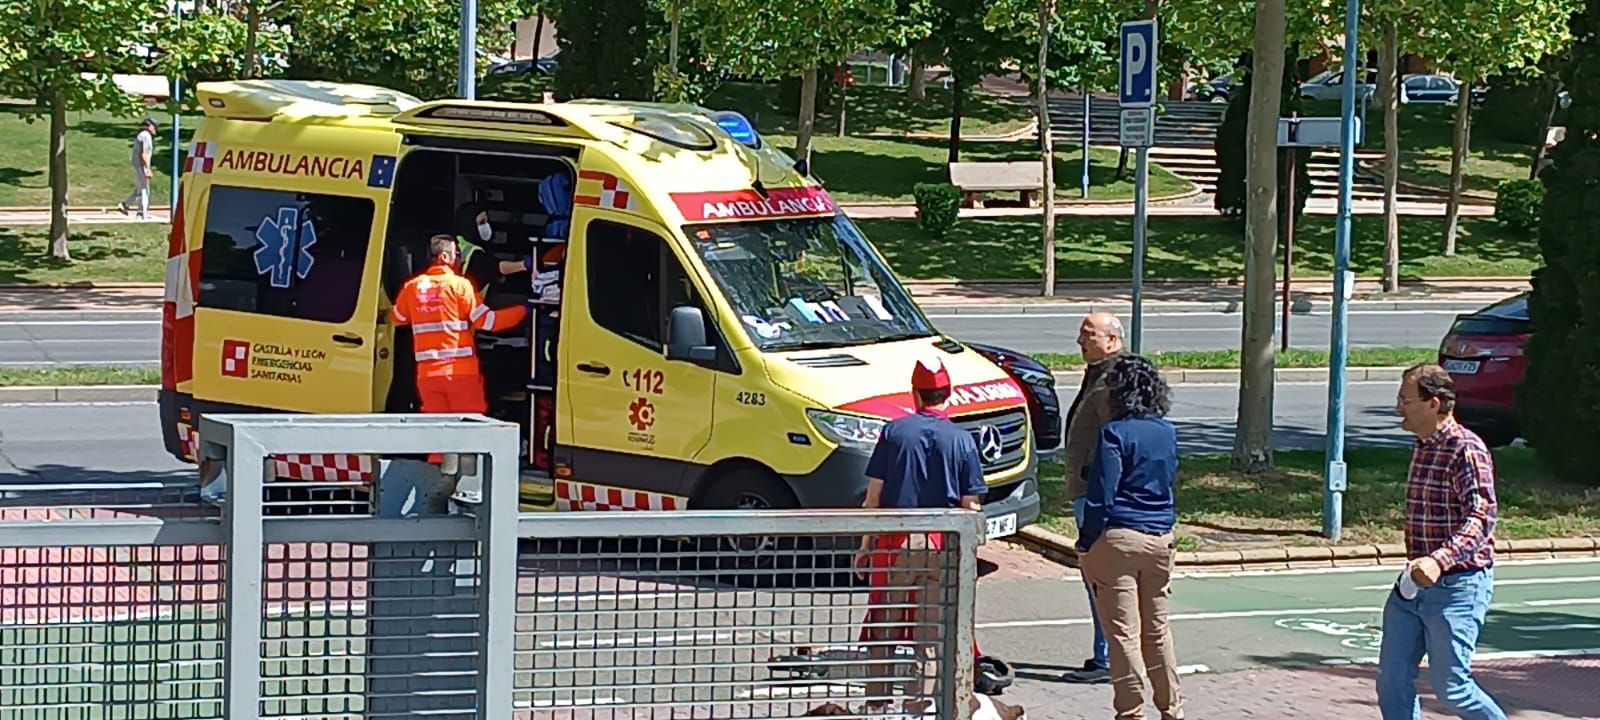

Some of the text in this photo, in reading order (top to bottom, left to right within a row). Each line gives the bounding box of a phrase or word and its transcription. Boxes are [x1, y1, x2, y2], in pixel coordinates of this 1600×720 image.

[219, 149, 363, 180] AMBULANCIA
[703, 196, 832, 218] AMBULANCIA
[253, 343, 292, 356] CASTILLA
[251, 369, 302, 383] SANITARIAS
[633, 368, 664, 394] 112
[736, 391, 766, 406] 4283
